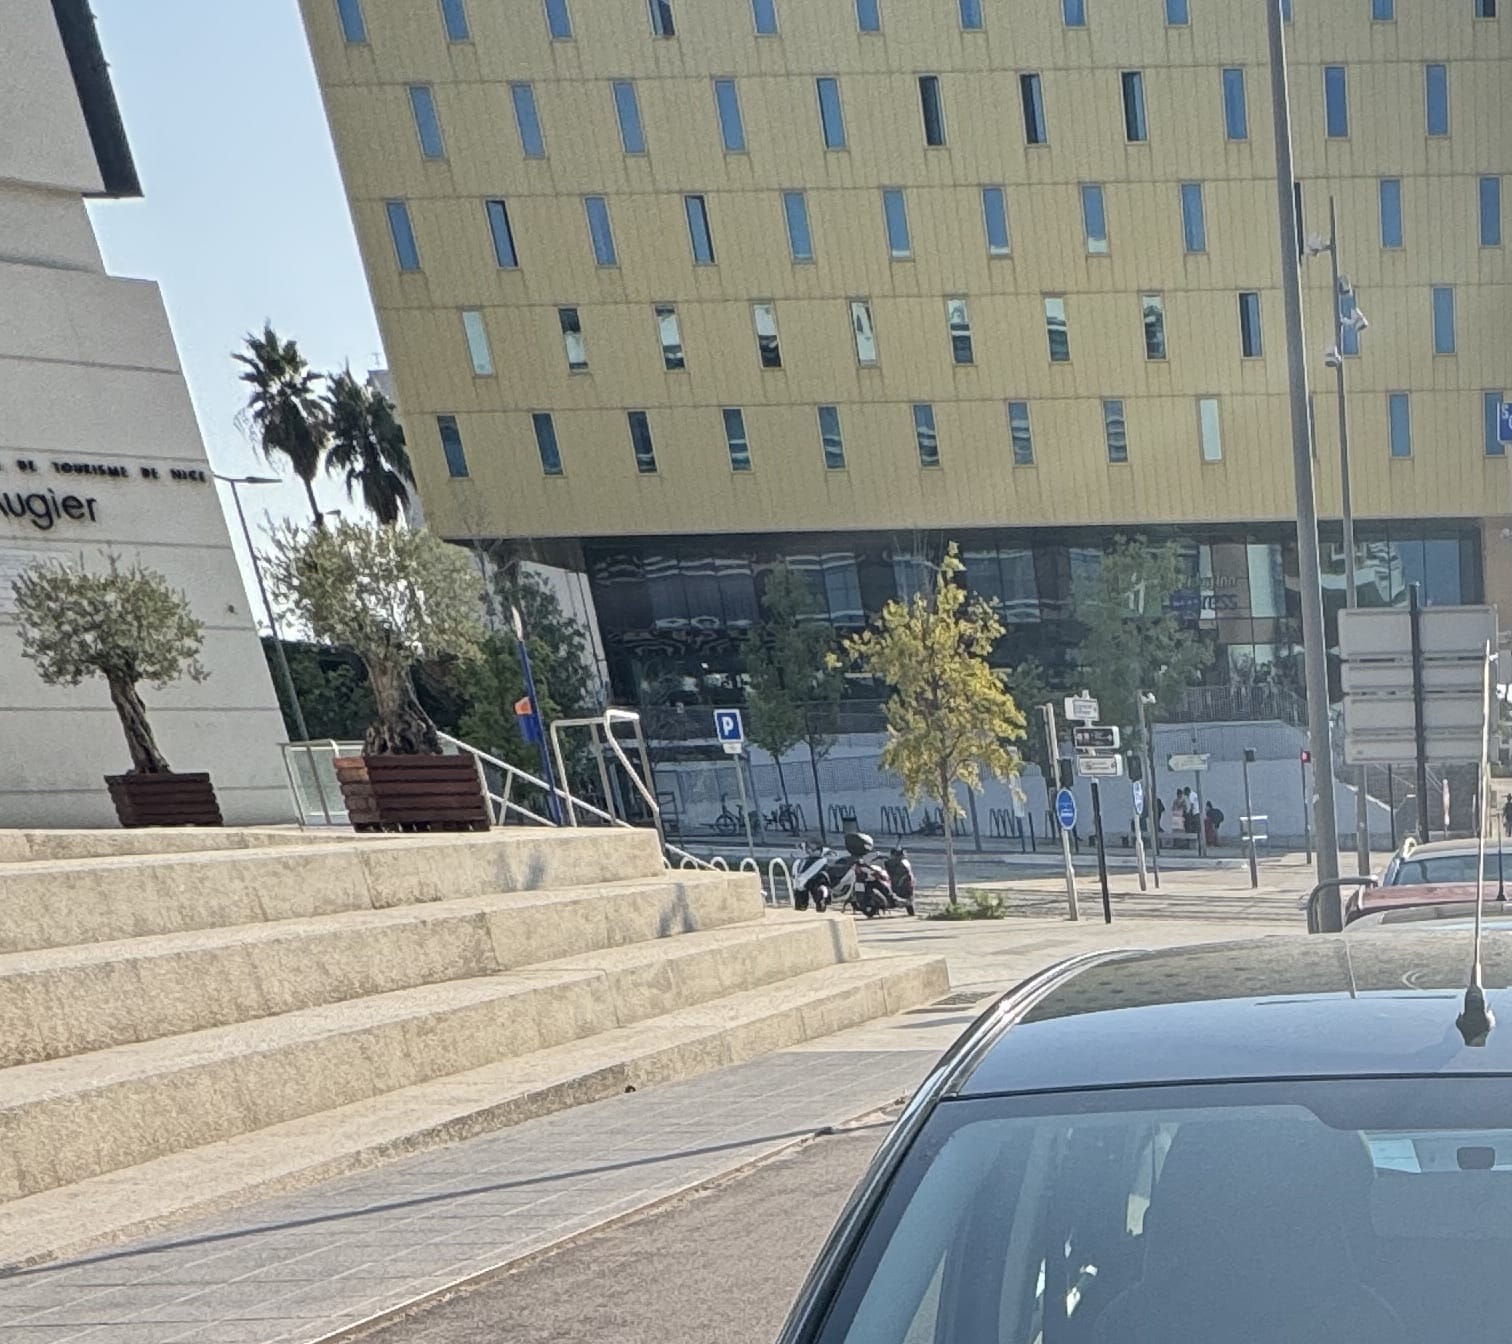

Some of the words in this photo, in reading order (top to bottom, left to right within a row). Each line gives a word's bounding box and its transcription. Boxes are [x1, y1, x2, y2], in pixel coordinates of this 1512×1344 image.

[17, 460, 37, 473] DE
[52, 461, 129, 478] TOURISME
[140, 467, 159, 480] DE
[170, 468, 207, 483] NICE
[722, 716, 733, 736] P
